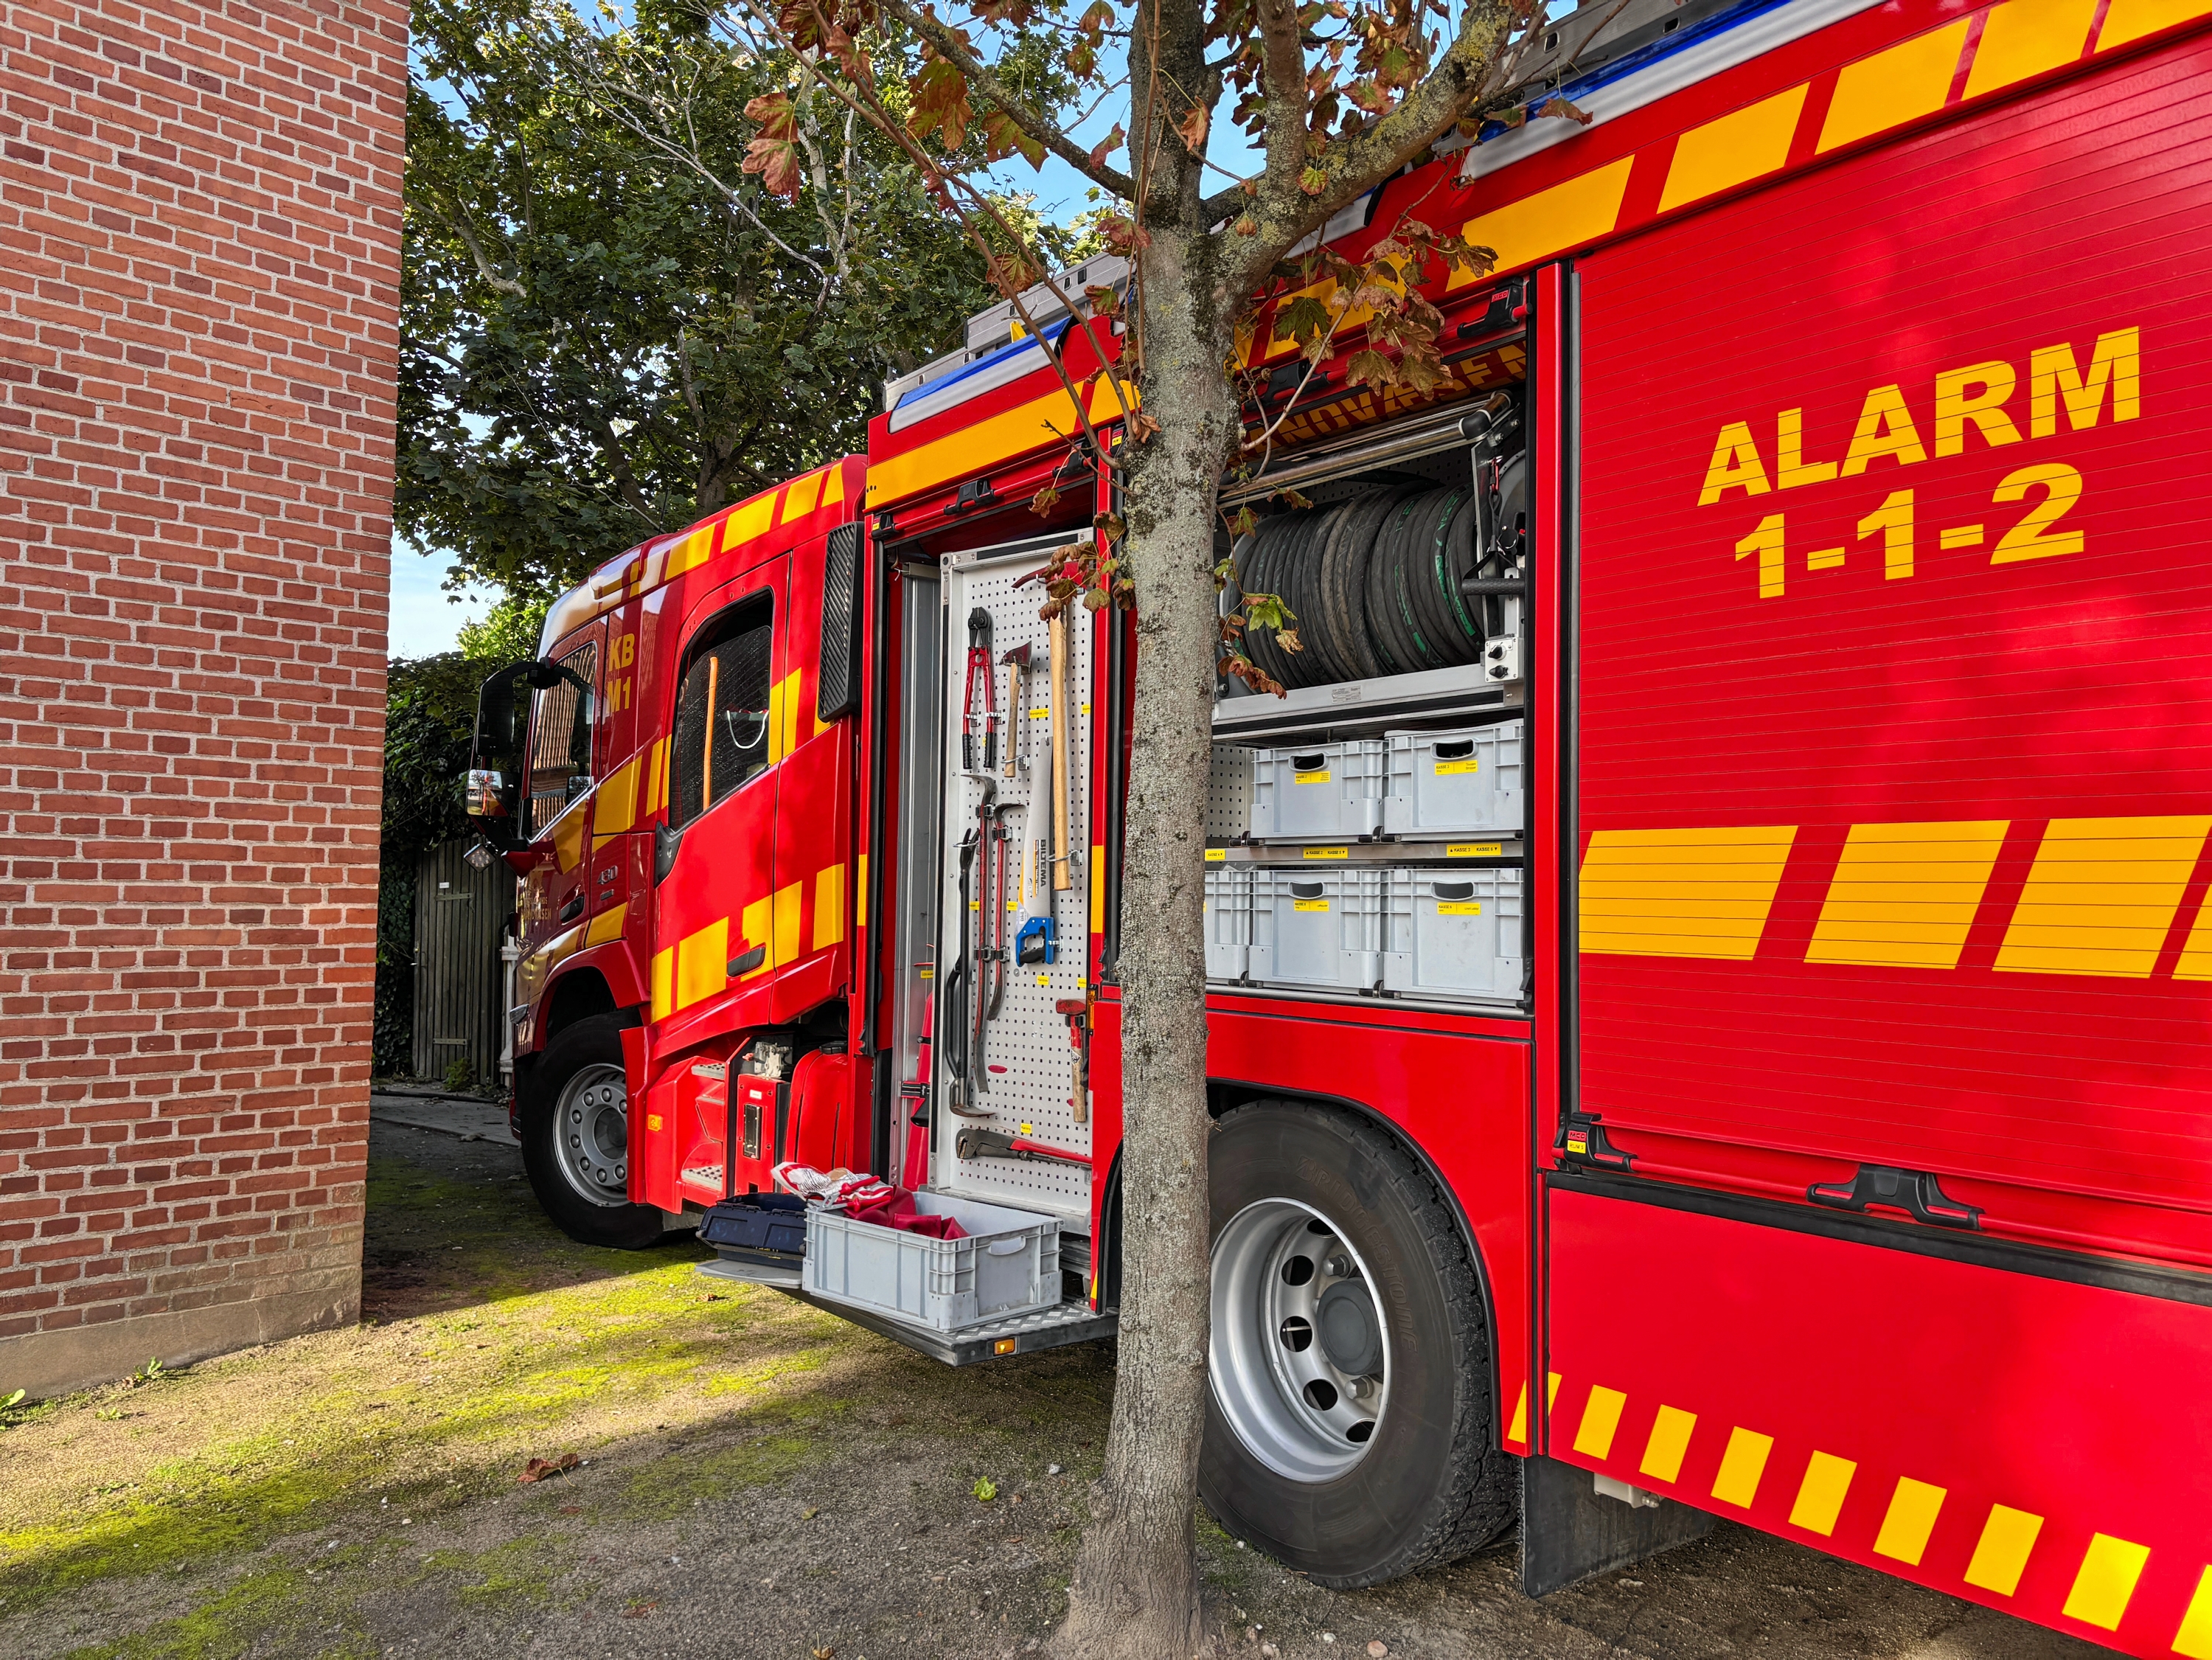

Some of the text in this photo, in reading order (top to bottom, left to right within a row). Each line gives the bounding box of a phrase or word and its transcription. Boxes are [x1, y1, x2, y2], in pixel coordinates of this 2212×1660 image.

[1697, 326, 2140, 507] ALARM
[1735, 463, 2084, 600] 1-1-2
[606, 676, 631, 715] M1
[608, 633, 635, 672] KB
[1295, 1154, 1418, 1352] BRIDGESTONE
